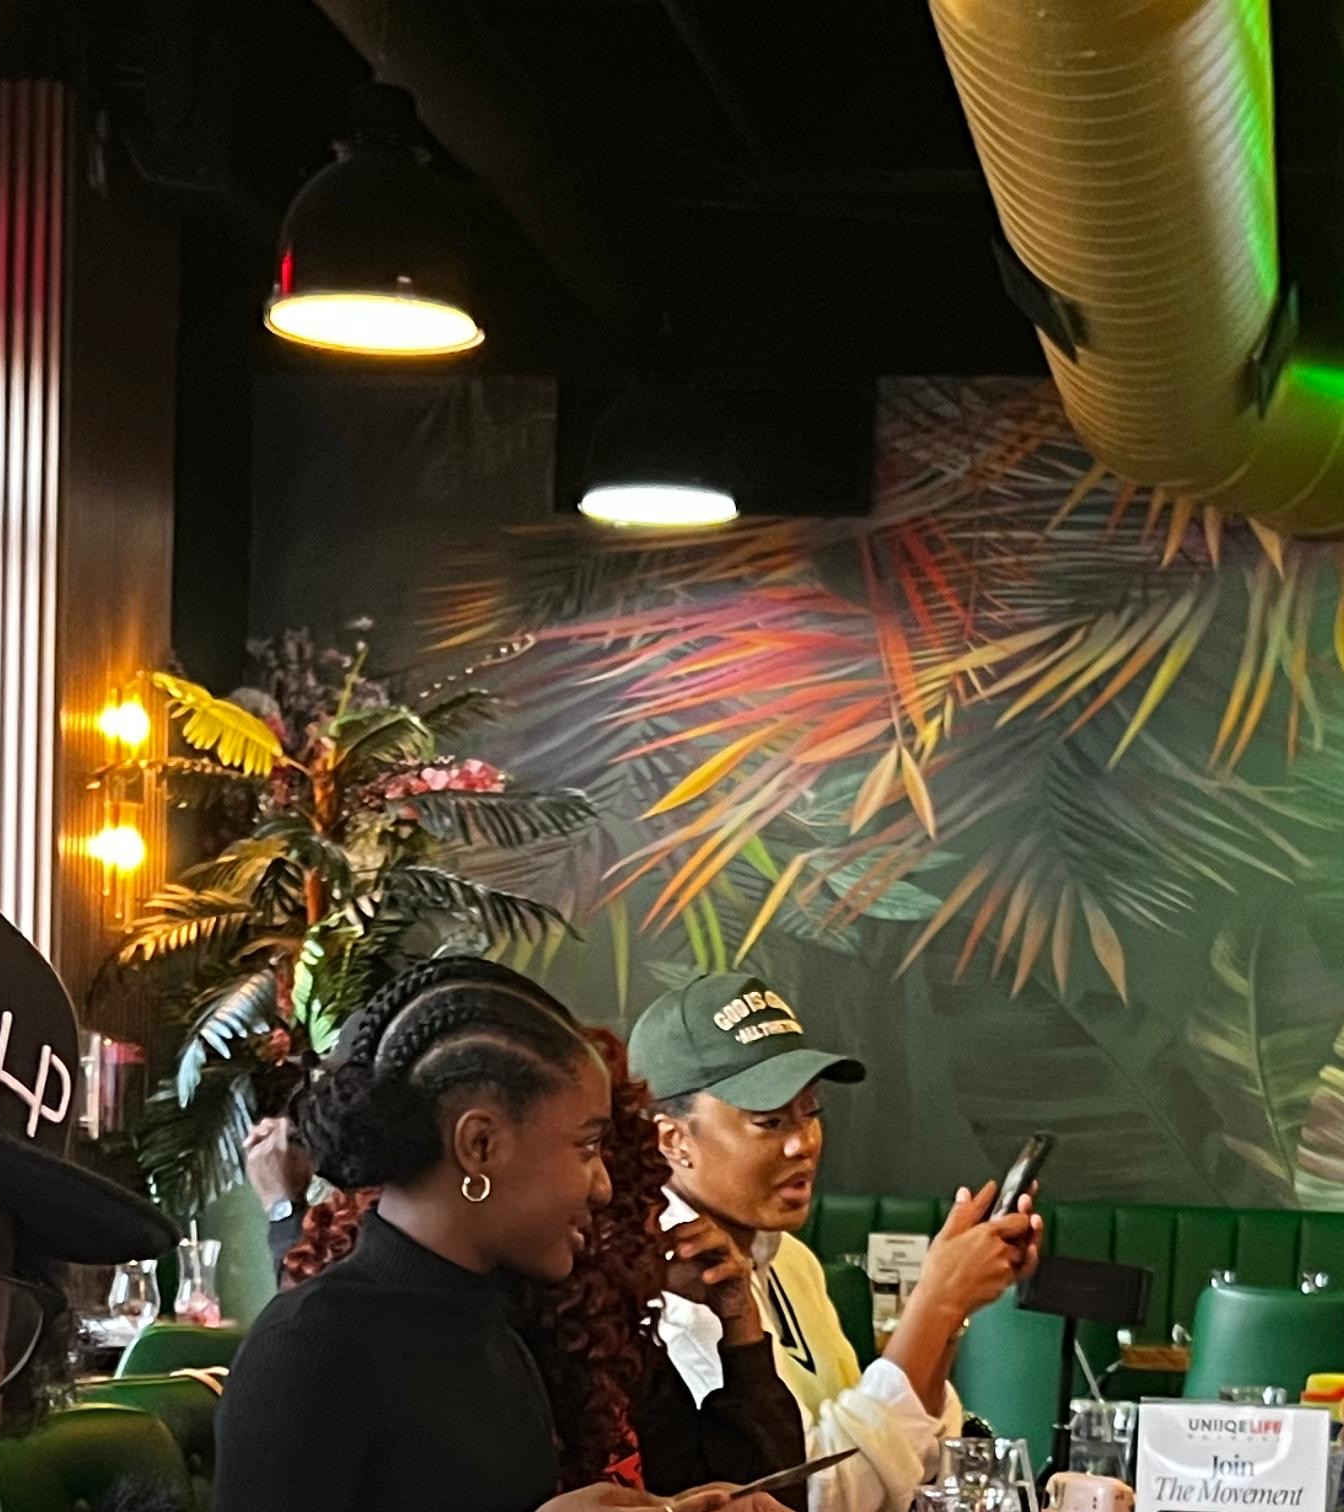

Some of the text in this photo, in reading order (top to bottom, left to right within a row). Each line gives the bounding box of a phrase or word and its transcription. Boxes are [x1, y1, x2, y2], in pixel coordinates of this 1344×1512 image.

[1211, 1453, 1255, 1479] Join
[1156, 1476, 1304, 1506] The Movement
